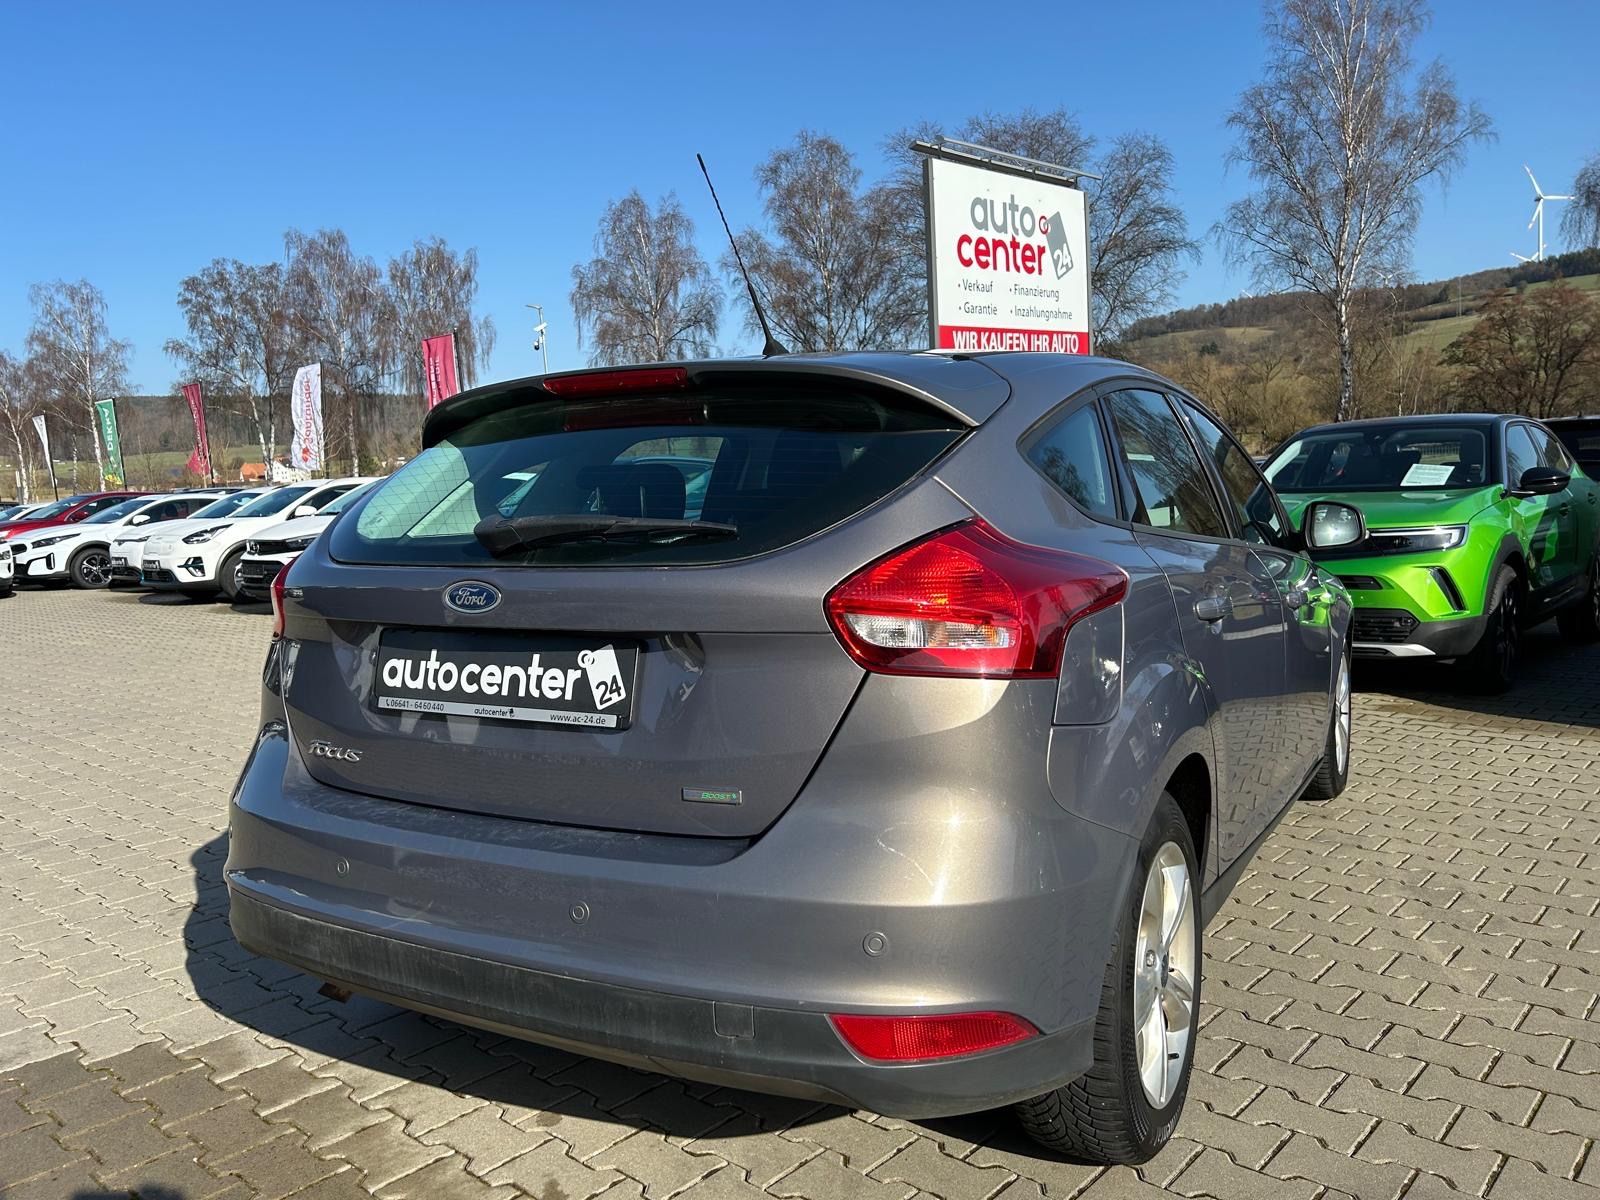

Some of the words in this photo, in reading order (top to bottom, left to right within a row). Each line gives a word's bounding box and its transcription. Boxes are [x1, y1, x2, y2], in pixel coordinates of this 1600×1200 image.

[970, 194, 1036, 238] auto
[957, 233, 1046, 276] center
[1053, 243, 1073, 273] 24
[962, 279, 993, 293] Verkauf
[1014, 284, 1060, 302] Finanzierung
[963, 302, 998, 316] Garantie
[1014, 306, 1073, 321] Inzahlungnahme
[952, 330, 978, 351] WIR
[981, 332, 1029, 352] KAUFEN
[1031, 334, 1049, 352] IHR
[1051, 333, 1079, 353] AUTO
[455, 588, 487, 606] Ford
[595, 674, 622, 705] 24
[474, 707, 508, 717] autocenter
[550, 714, 606, 725] www.ac-24.de
